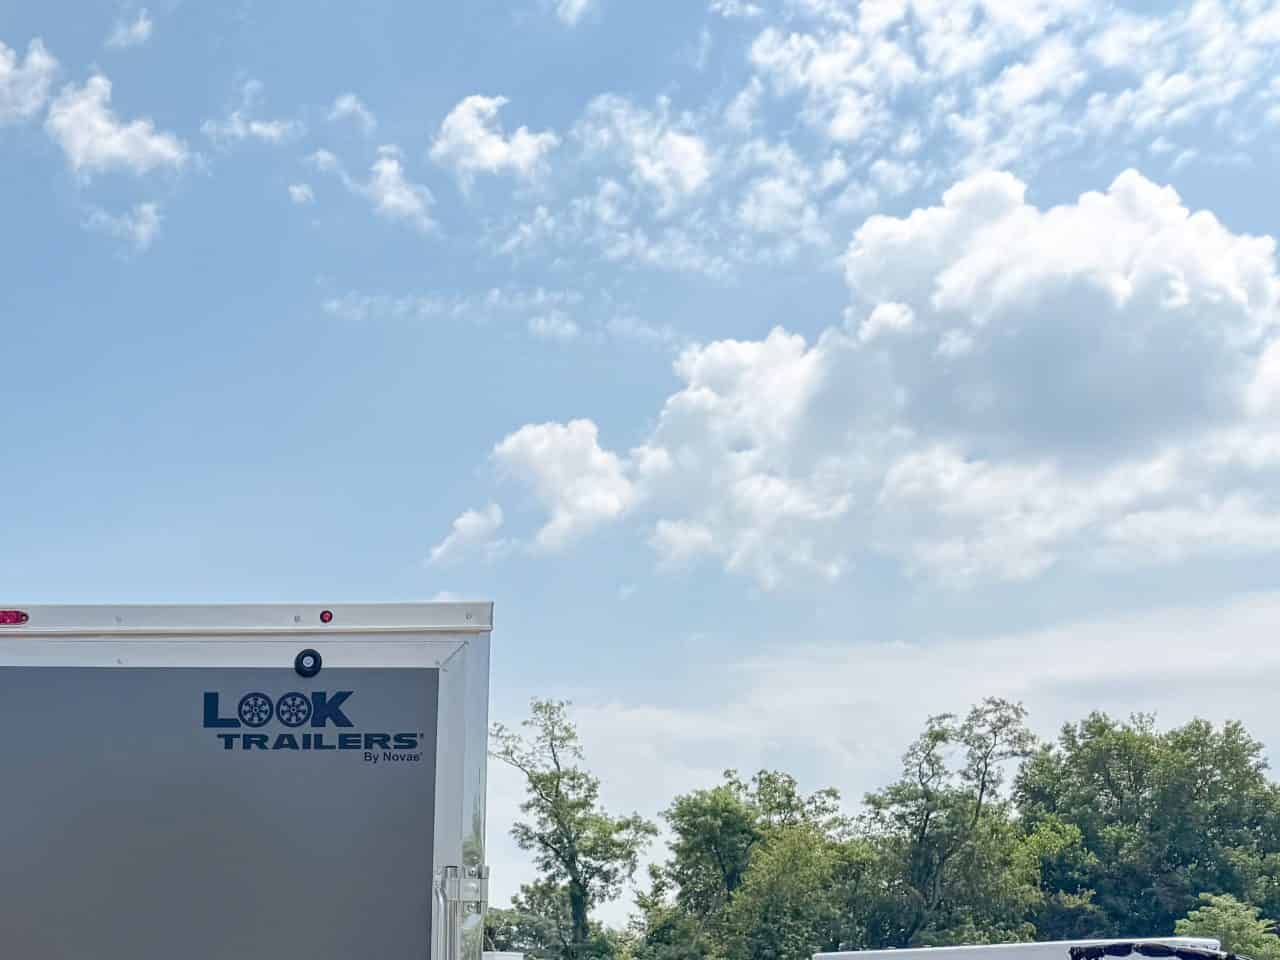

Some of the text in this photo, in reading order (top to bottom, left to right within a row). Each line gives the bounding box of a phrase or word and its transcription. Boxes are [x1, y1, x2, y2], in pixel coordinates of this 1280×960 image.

[203, 691, 354, 728] LOOK
[217, 733, 419, 750] TRAILERS
[364, 752, 379, 763] By
